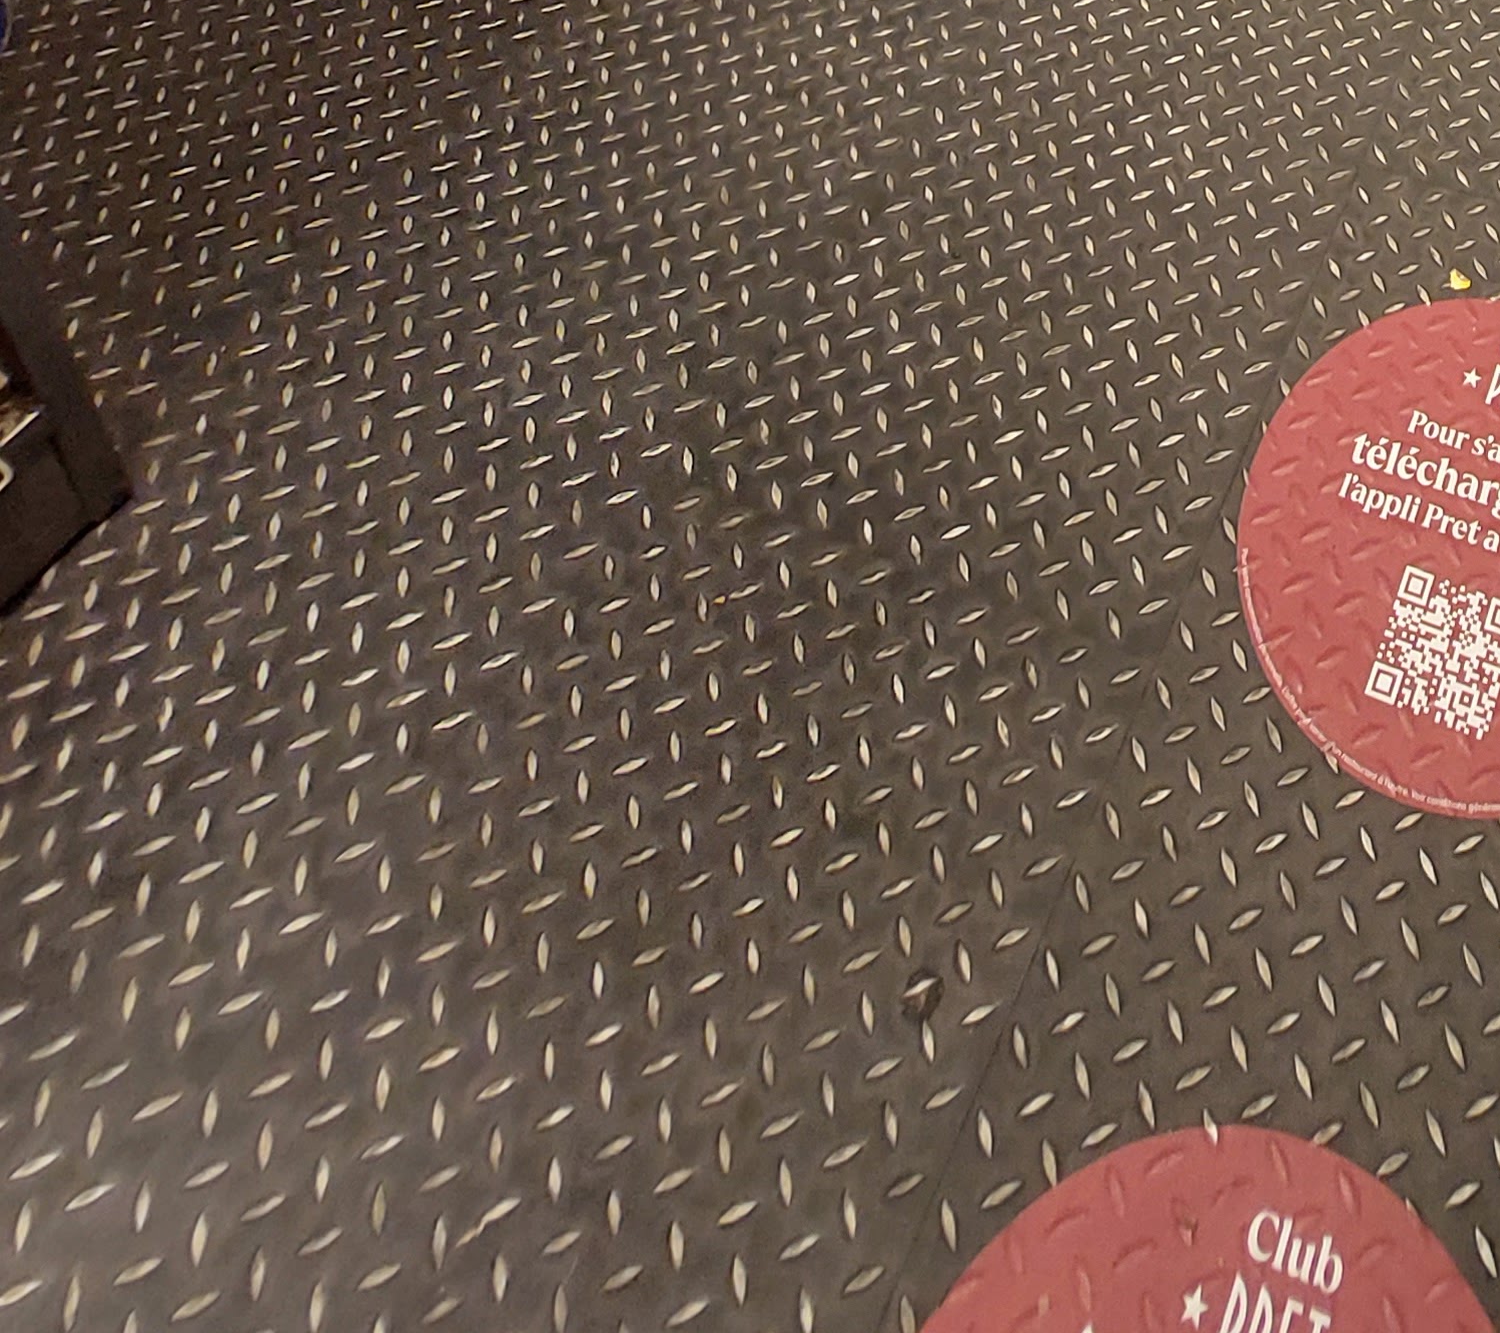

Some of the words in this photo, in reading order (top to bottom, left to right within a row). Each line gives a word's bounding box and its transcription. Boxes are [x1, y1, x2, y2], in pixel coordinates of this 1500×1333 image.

[1407, 409, 1471, 452] Pour
[1339, 473, 1421, 525] l'appli
[1422, 504, 1482, 548] Pret
[1482, 528, 1500, 554] a
[1248, 1209, 1343, 1295] Club
